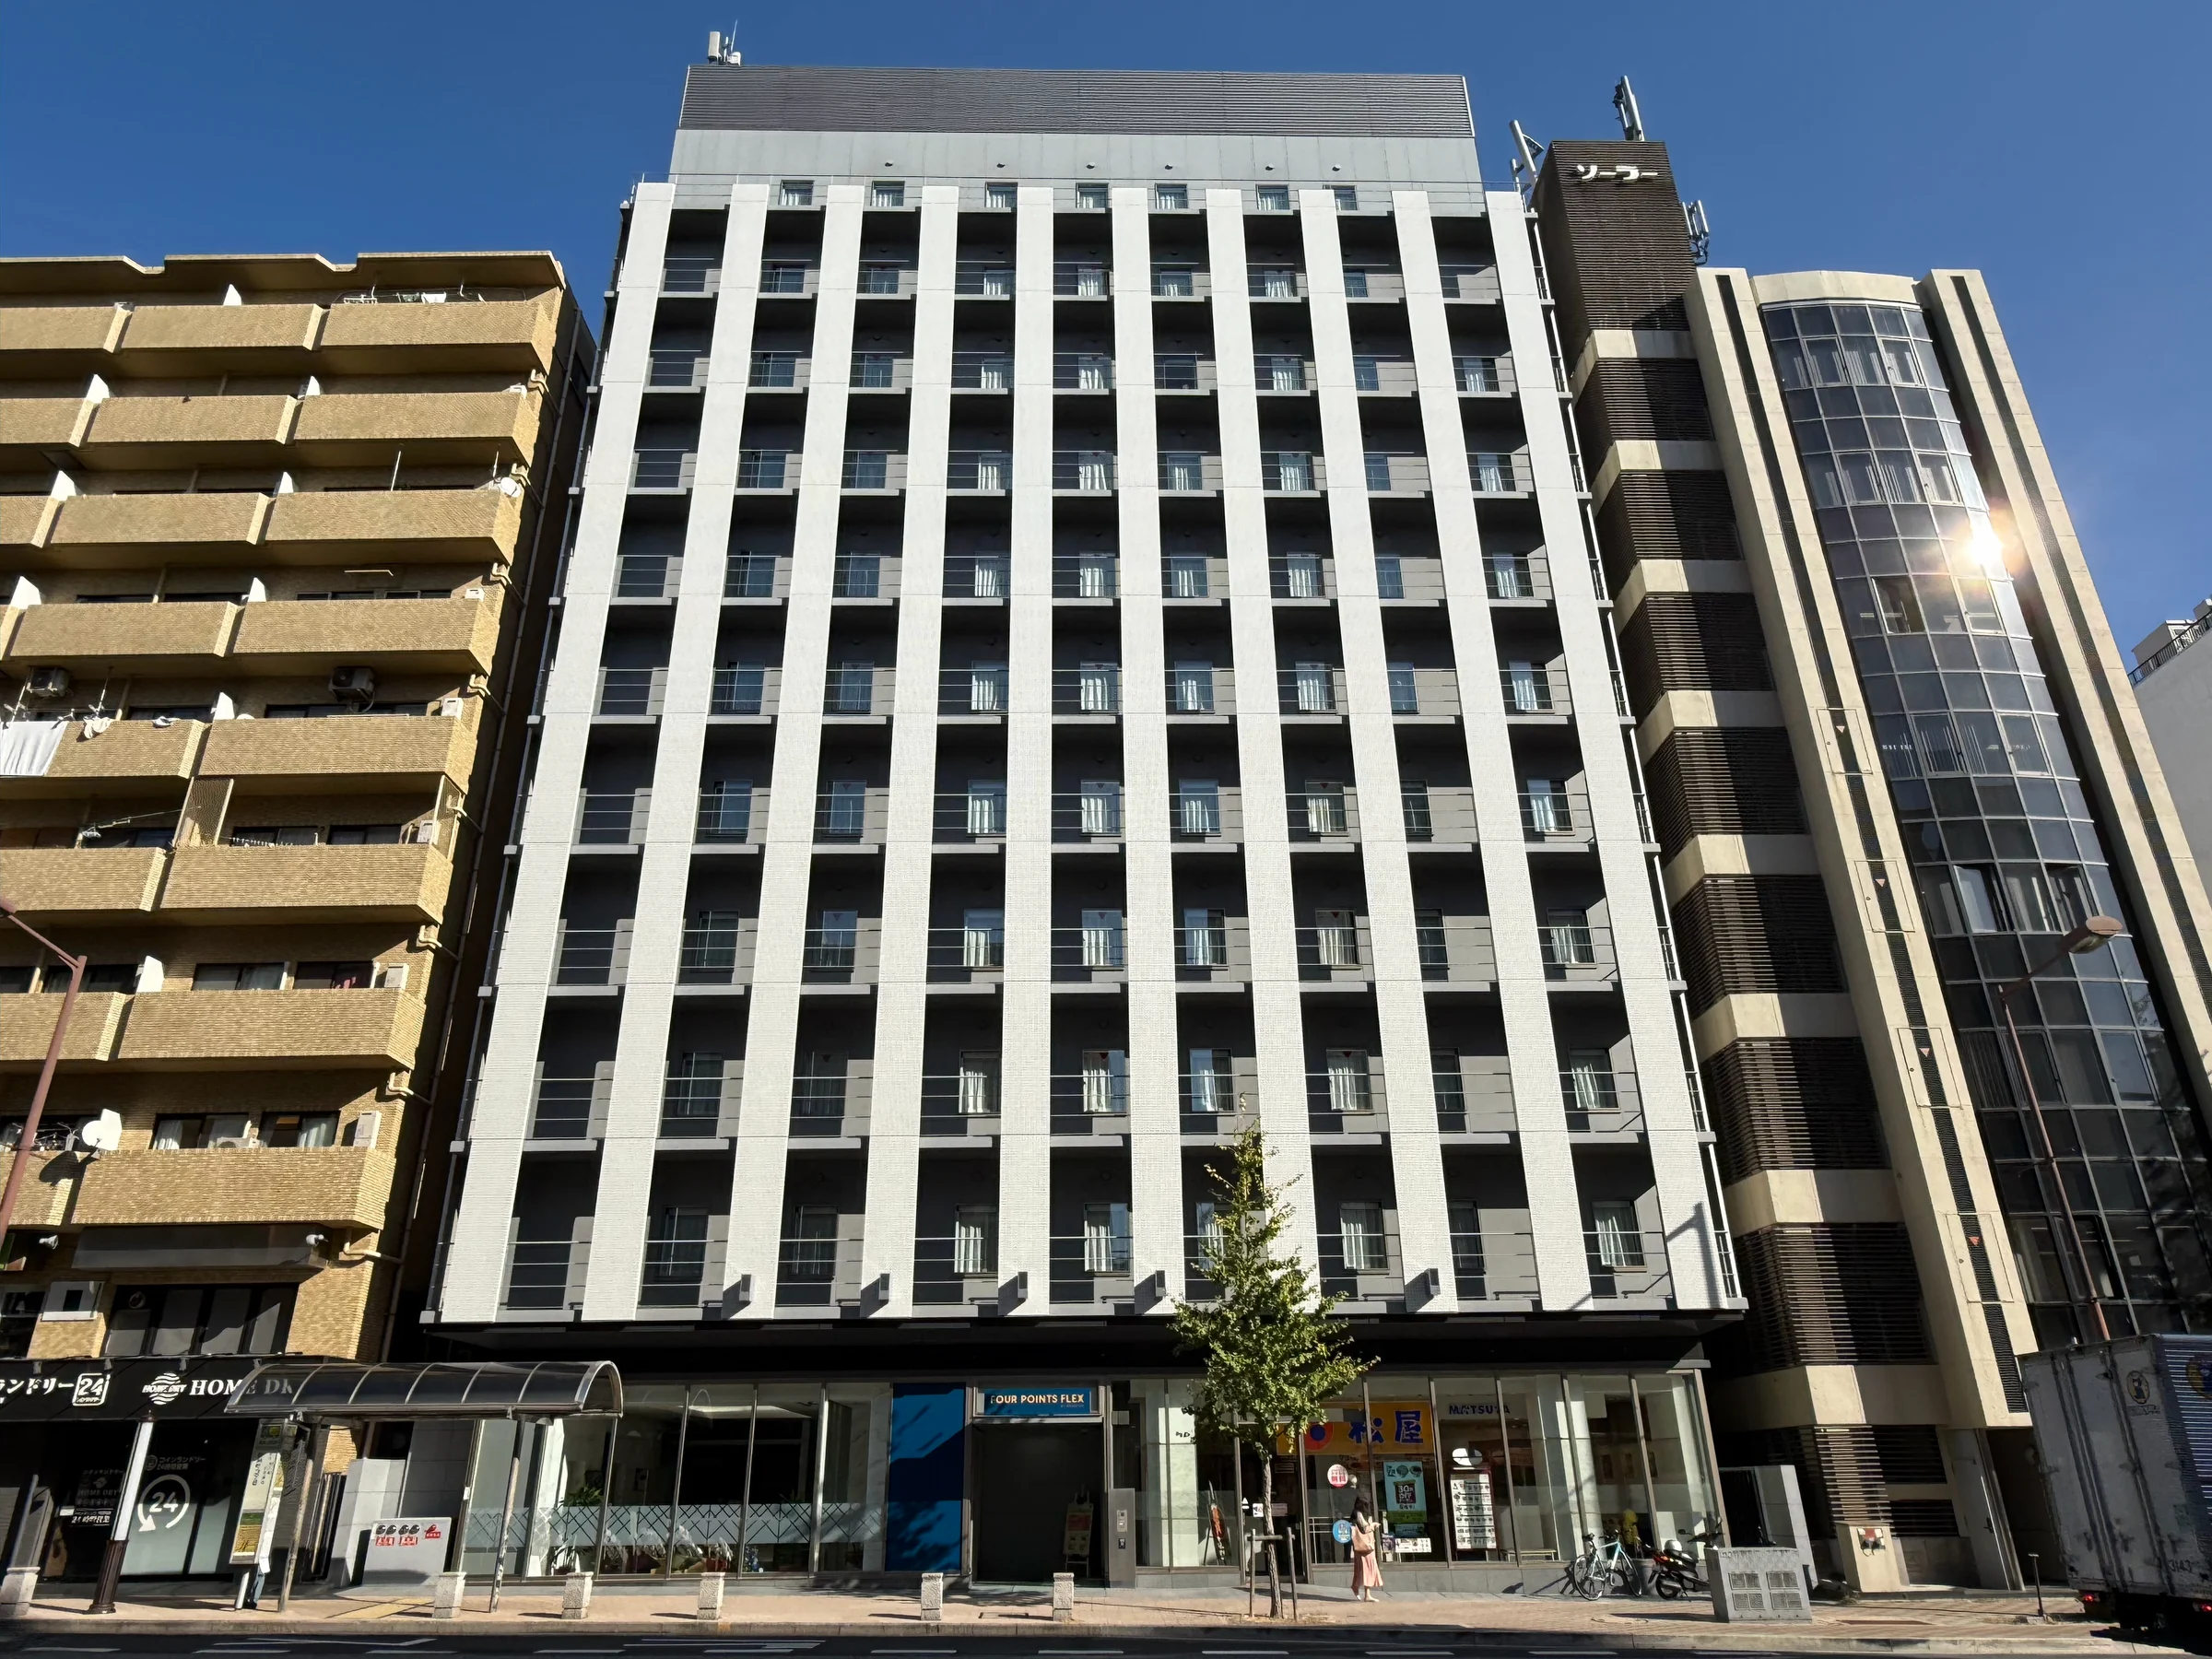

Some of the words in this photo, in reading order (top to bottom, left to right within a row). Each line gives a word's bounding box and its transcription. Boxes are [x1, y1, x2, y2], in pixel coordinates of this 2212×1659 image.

[1577, 165, 1658, 180] ソーラー
[78, 1378, 104, 1395] 24
[264, 1379, 292, 1394] DR
[991, 1395, 1018, 1404] FOUR
[1020, 1394, 1058, 1404] POINTS
[1061, 1394, 1085, 1403] FLEX
[1348, 1410, 1424, 1444] 松屋
[149, 1491, 179, 1512] 24
